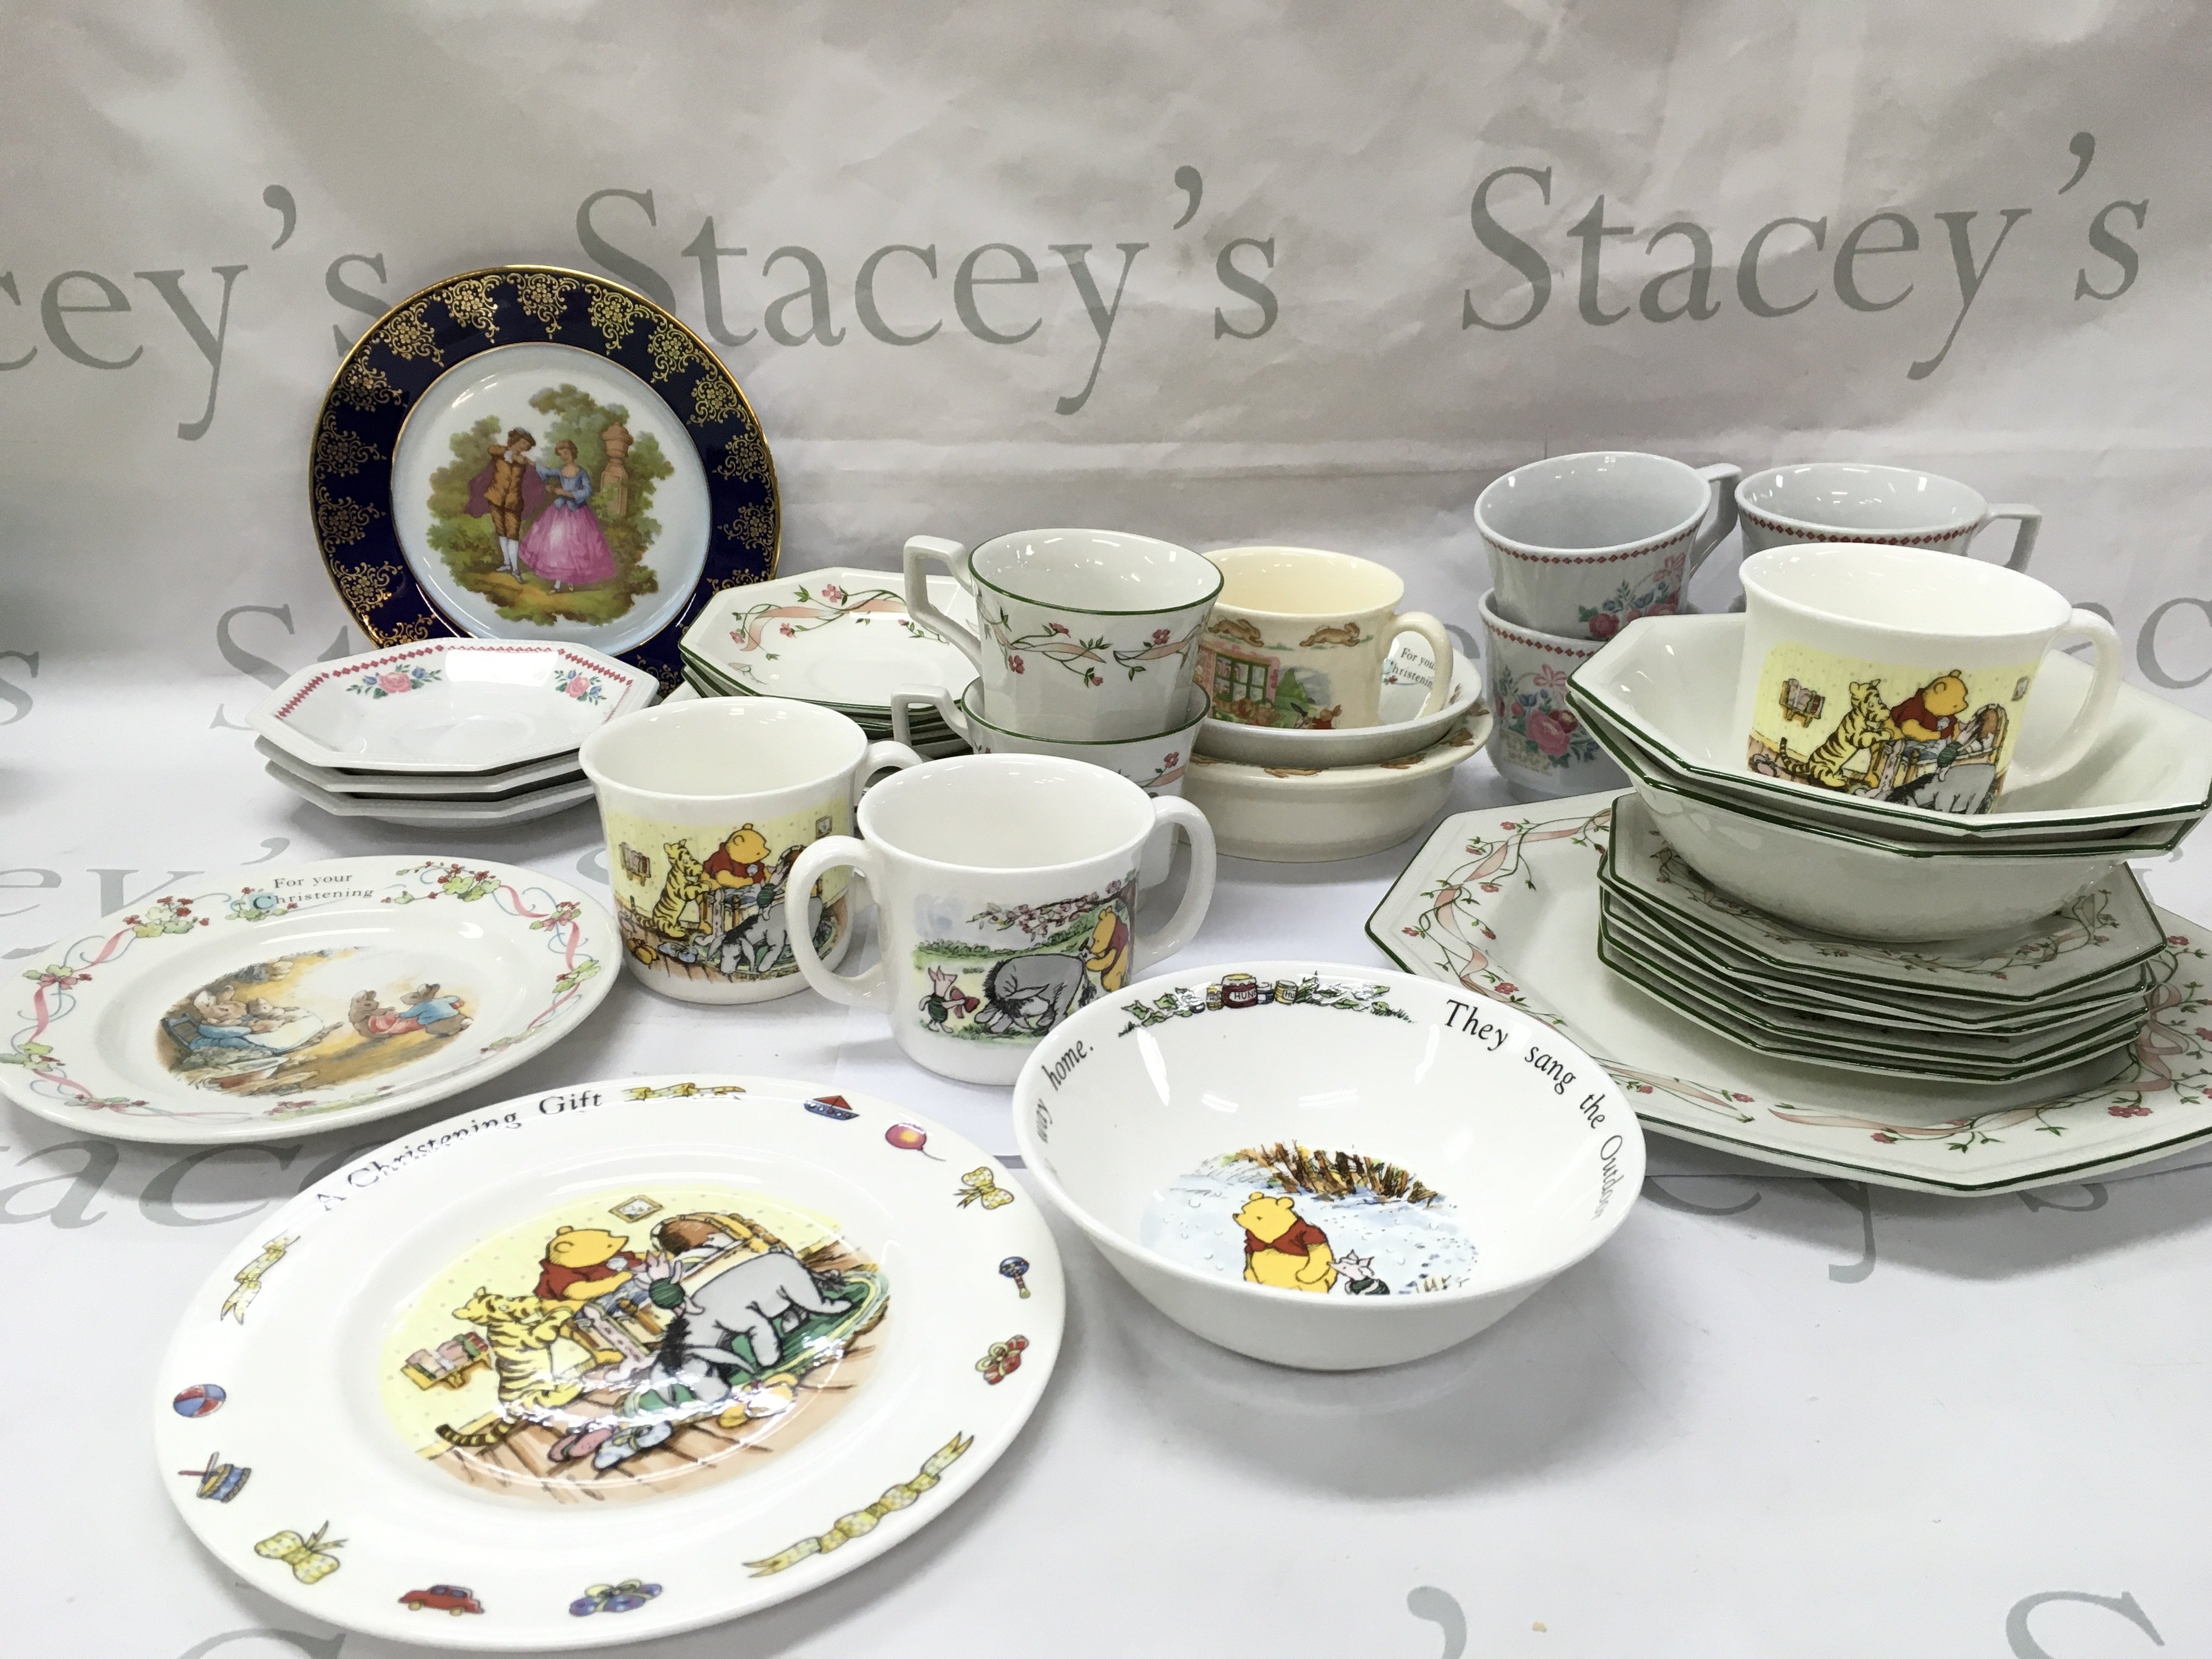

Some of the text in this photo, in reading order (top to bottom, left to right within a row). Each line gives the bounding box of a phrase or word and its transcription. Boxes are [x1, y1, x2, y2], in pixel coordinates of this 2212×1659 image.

[1462, 132, 2149, 380] Stacey's
[575, 165, 1279, 415] Stacey's
[1383, 660, 1434, 690] hristenin
[1400, 647, 1435, 671] For you
[252, 888, 374, 910] Christening
[273, 874, 353, 889] For your
[1041, 1040, 1094, 1091] home.
[1444, 998, 1509, 1051] They
[1524, 1046, 1577, 1095] sang
[1579, 1093, 1605, 1129] the
[317, 1090, 603, 1211] A Christening Gift
